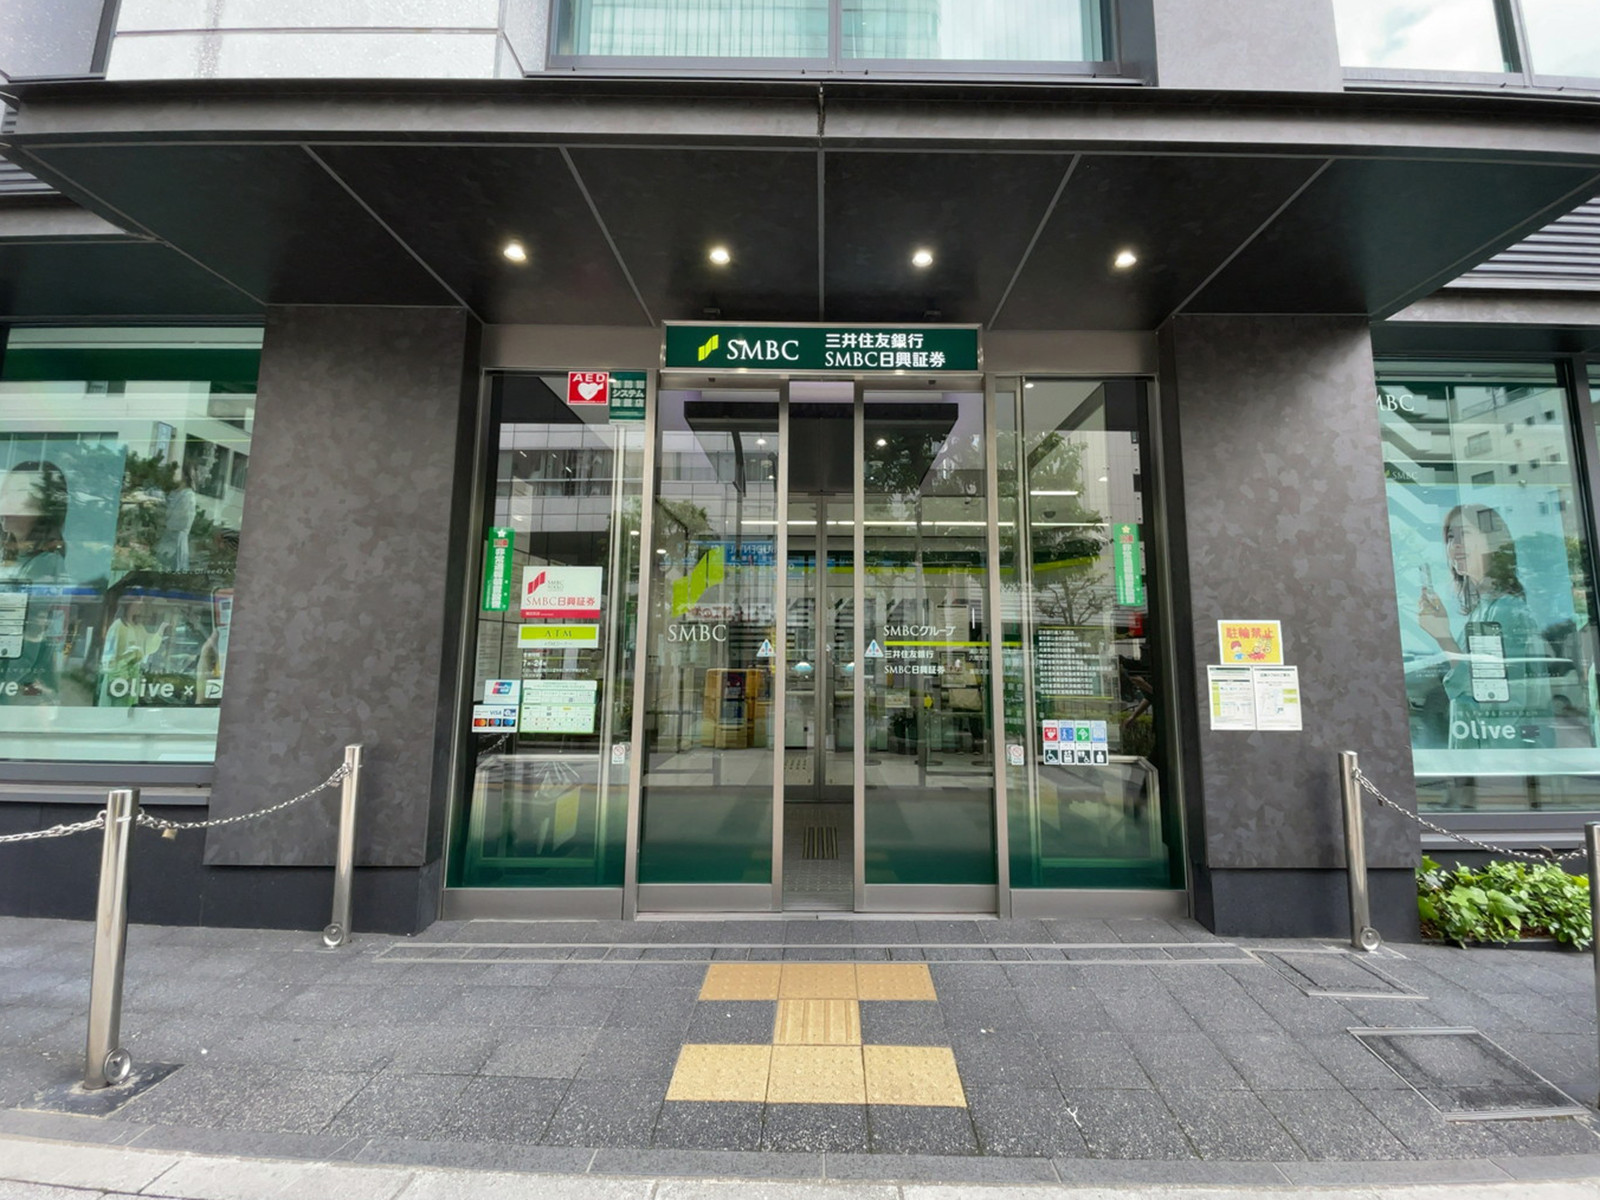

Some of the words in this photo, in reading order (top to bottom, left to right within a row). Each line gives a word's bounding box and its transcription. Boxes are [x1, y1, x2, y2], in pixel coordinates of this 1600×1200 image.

[825, 333, 923, 349] 三井住友銀行
[726, 339, 799, 361] SMBC
[825, 351, 946, 368] SMBC日興証券
[572, 373, 606, 382] AED
[612, 389, 645, 398] システム
[526, 596, 596, 606] SMBC日興証券
[667, 624, 727, 642] SMBC
[883, 625, 956, 637] SMBCグループ
[884, 650, 934, 659] 三井住友銀行
[884, 665, 945, 675] SMBC日興証券
[109, 678, 174, 697] Olive
[1452, 720, 1516, 739] Olive
